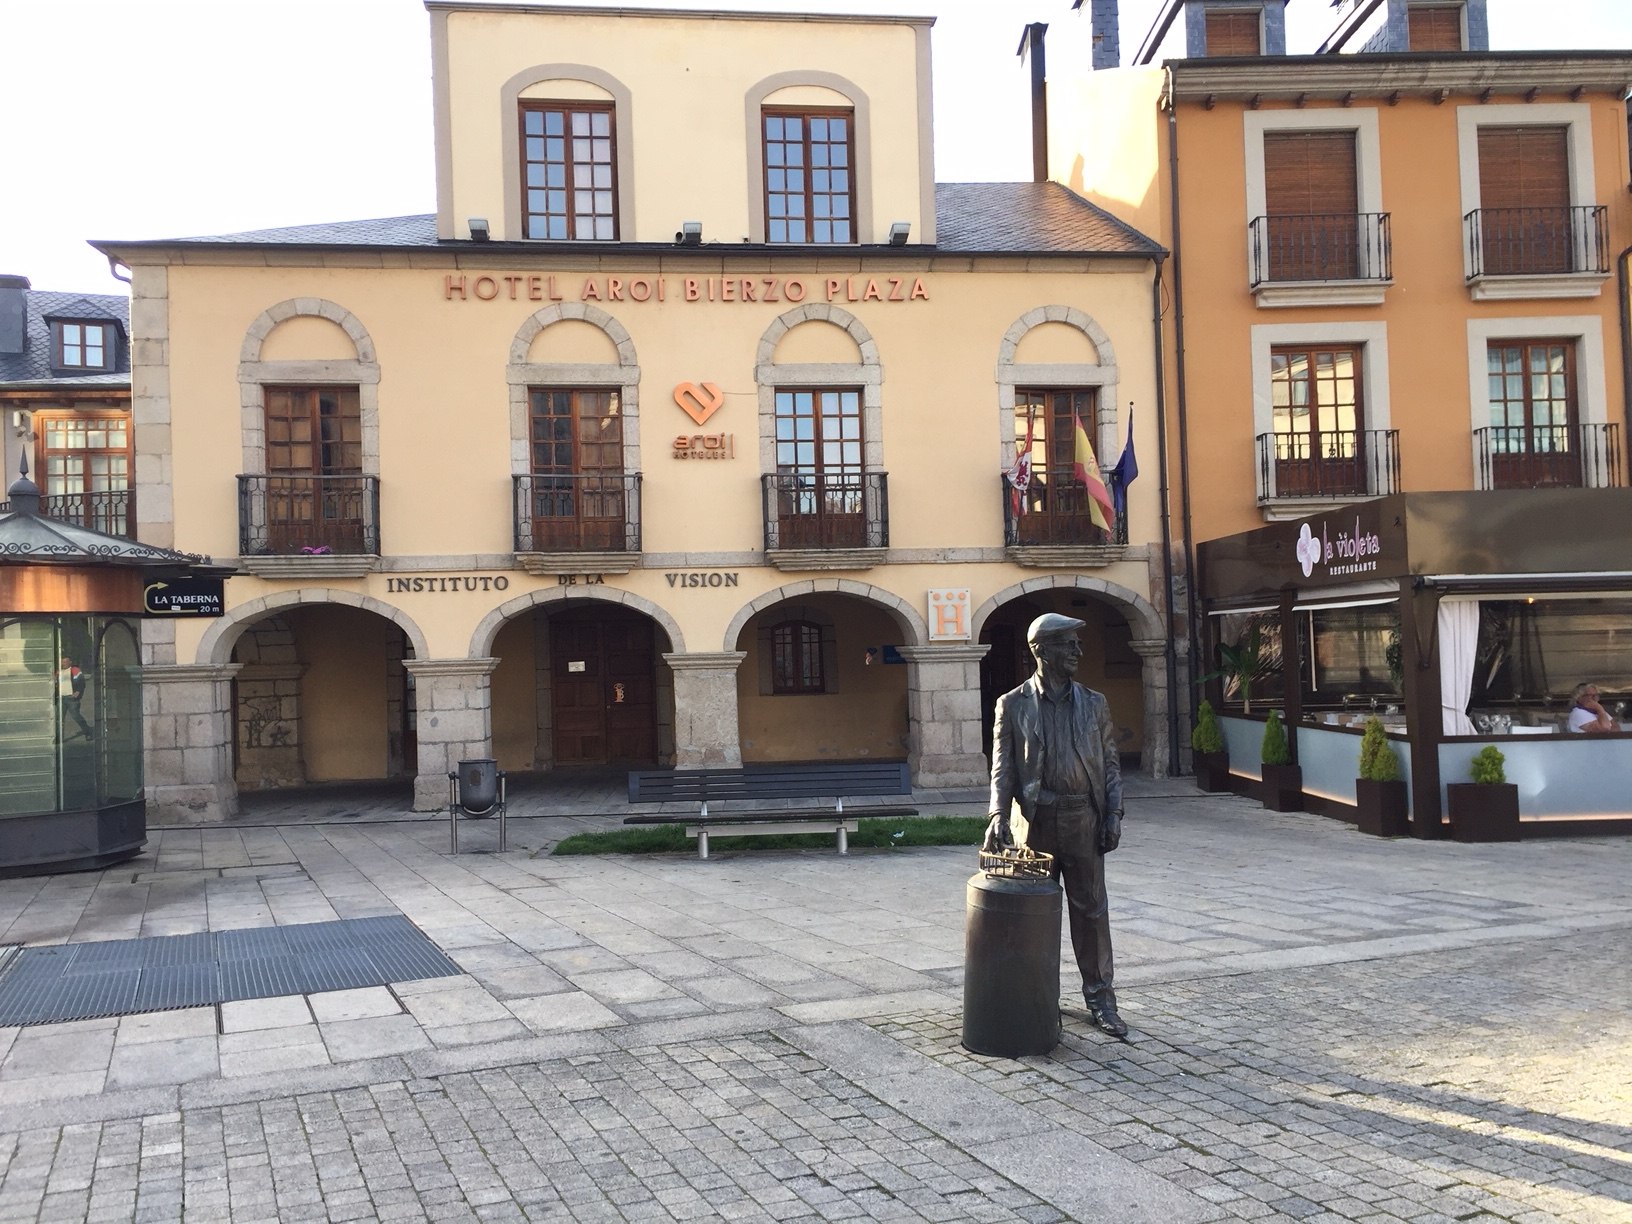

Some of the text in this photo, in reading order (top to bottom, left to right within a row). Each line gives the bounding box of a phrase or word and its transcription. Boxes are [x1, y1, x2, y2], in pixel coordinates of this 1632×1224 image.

[445, 275, 930, 303] HOTEL AROI BIERZO PLAZA
[673, 432, 726, 449] aroi
[1323, 516, 1380, 565] la violeta
[1330, 561, 1376, 575] RESTAURANTE
[387, 573, 739, 592] INSTITUTO DE LA VISION
[155, 595, 218, 604] LA TABERNA
[200, 605, 210, 613] 20
[933, 604, 968, 636] H
